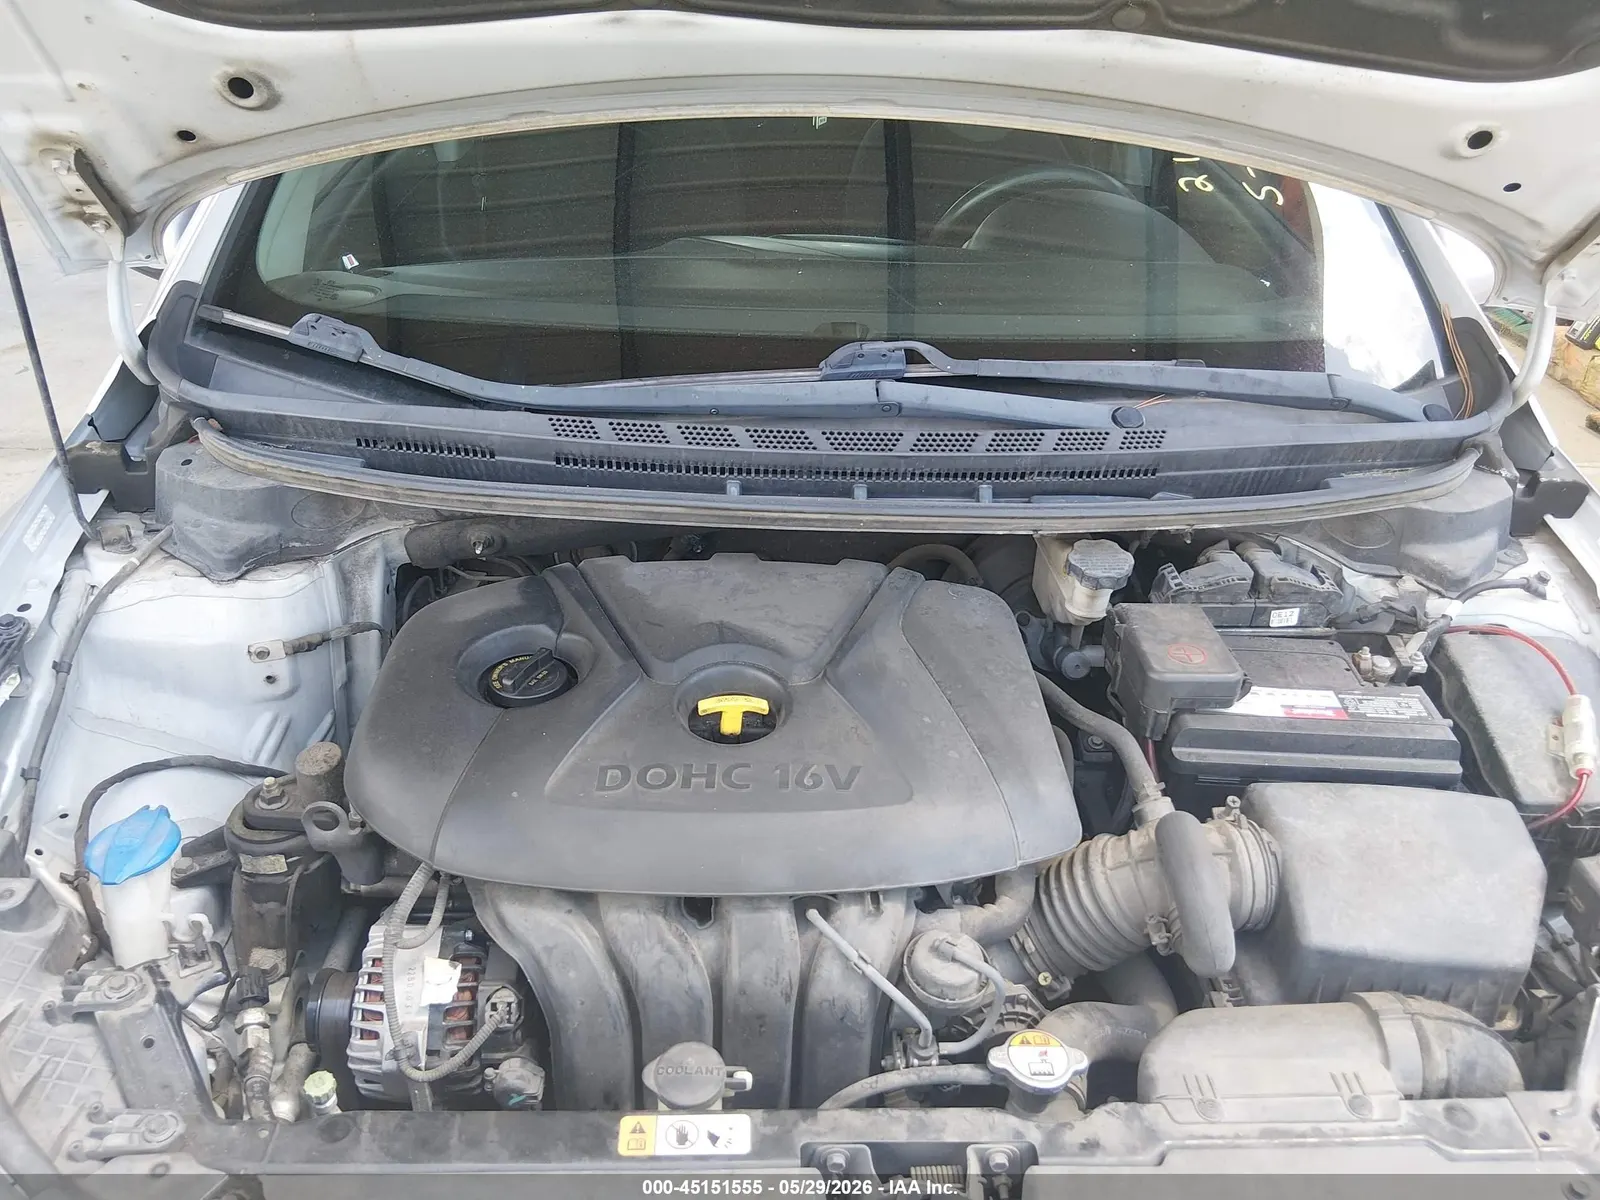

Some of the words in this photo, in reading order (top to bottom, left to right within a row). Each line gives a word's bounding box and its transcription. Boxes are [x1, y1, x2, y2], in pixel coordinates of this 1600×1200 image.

[595, 763, 754, 792] DOHC
[773, 764, 863, 791] 16V
[656, 1065, 723, 1077] COOLANT
